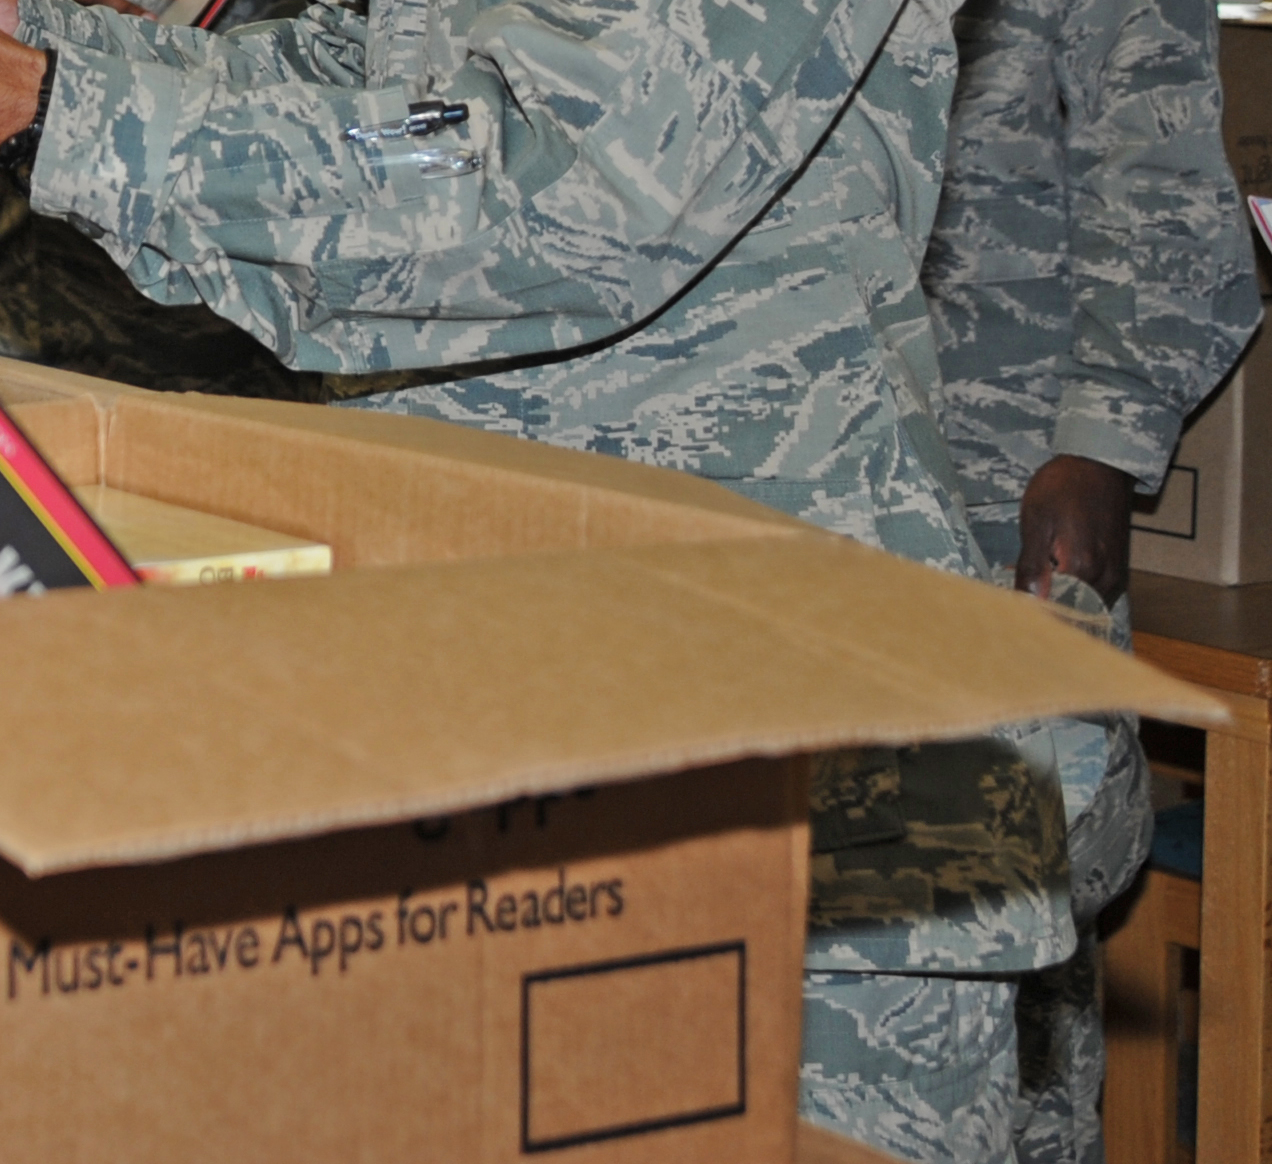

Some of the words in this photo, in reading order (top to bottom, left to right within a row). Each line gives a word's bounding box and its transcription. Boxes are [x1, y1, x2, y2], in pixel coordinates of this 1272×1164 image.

[6, 918, 261, 1000] Must-Have
[270, 903, 386, 976] Apps
[396, 884, 461, 946] for
[464, 866, 624, 937] Readers
